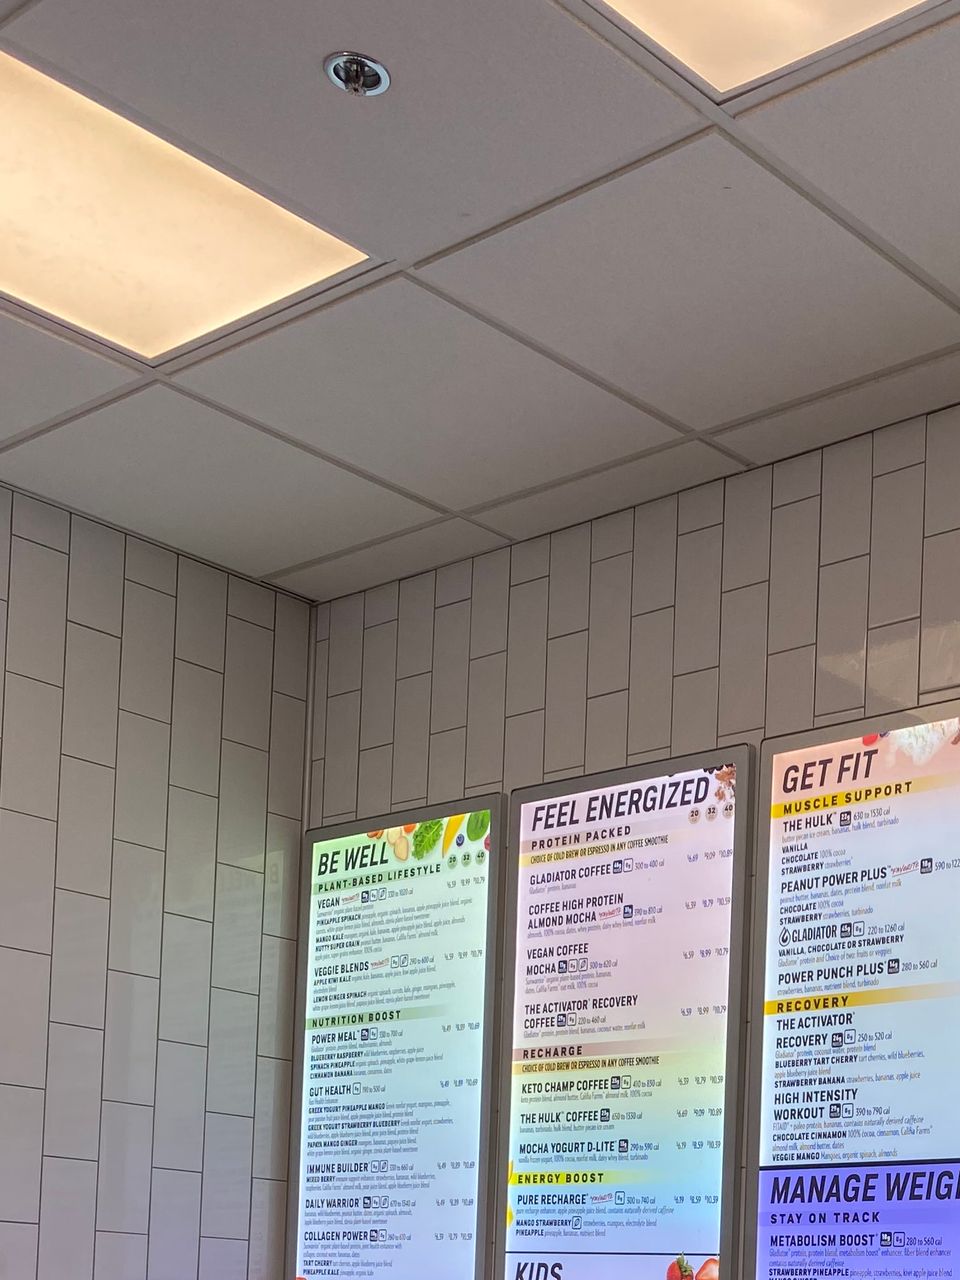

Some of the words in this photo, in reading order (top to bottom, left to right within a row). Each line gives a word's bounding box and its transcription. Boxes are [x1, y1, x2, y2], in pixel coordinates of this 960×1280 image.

[782, 757, 834, 794] GET
[836, 748, 879, 784] FIT
[531, 799, 580, 832] FEEL
[585, 776, 710, 823] ENERGIZED
[783, 794, 838, 816] MUSCLE
[844, 781, 912, 804] SUPPORT
[531, 833, 581, 851] PROTEIN
[585, 825, 631, 842] PACKED
[781, 842, 808, 854] VANILLA
[317, 850, 341, 877] BE
[344, 841, 389, 872] WELL
[781, 851, 819, 865] CHOCOLATE
[318, 873, 384, 893] PLANT-BASED
[387, 863, 441, 881] LIFESTYLE
[529, 868, 577, 886] GLADIATOR
[578, 863, 612, 879] COFFEE
[781, 862, 825, 876] STRAWBERRY
[781, 876, 821, 894] PEANUT
[822, 871, 859, 888] POWER
[317, 897, 340, 910] VEGAN
[528, 901, 561, 916] COFFEE
[561, 898, 584, 912] HIGH
[585, 893, 624, 909] PROTEIN
[527, 915, 564, 930] ALMOND
[565, 910, 597, 925] MOCHA
[791, 924, 838, 943] GLADIATOR
[526, 946, 555, 960] VEGAN
[556, 942, 589, 957] COFFEE
[314, 964, 340, 977] VEGGIE
[340, 960, 369, 974] BLENDS
[776, 995, 849, 1014] RECOVERY
[311, 1013, 364, 1028] NUTRITION
[368, 1009, 401, 1023] BOOST
[522, 1045, 583, 1060] RECHARGE
[775, 1058, 813, 1069] BLUEBERRY
[813, 1056, 830, 1066] TART
[830, 1054, 858, 1065] CHERRY
[309, 1086, 324, 1098] GUT
[324, 1084, 352, 1096] HEALTH
[774, 1091, 800, 1105] HIGH
[802, 1088, 858, 1104] INTENSITY
[773, 1106, 825, 1121] WORKOUT
[517, 1173, 561, 1185] ENERGY
[565, 1172, 604, 1184] BOOST
[769, 1173, 880, 1205] MANAGE
[770, 1212, 803, 1225] STAY
[808, 1212, 827, 1224] ON
[833, 1211, 880, 1224] TRACK
[304, 1231, 341, 1242] COLLAGEN
[342, 1230, 369, 1241] POWER
